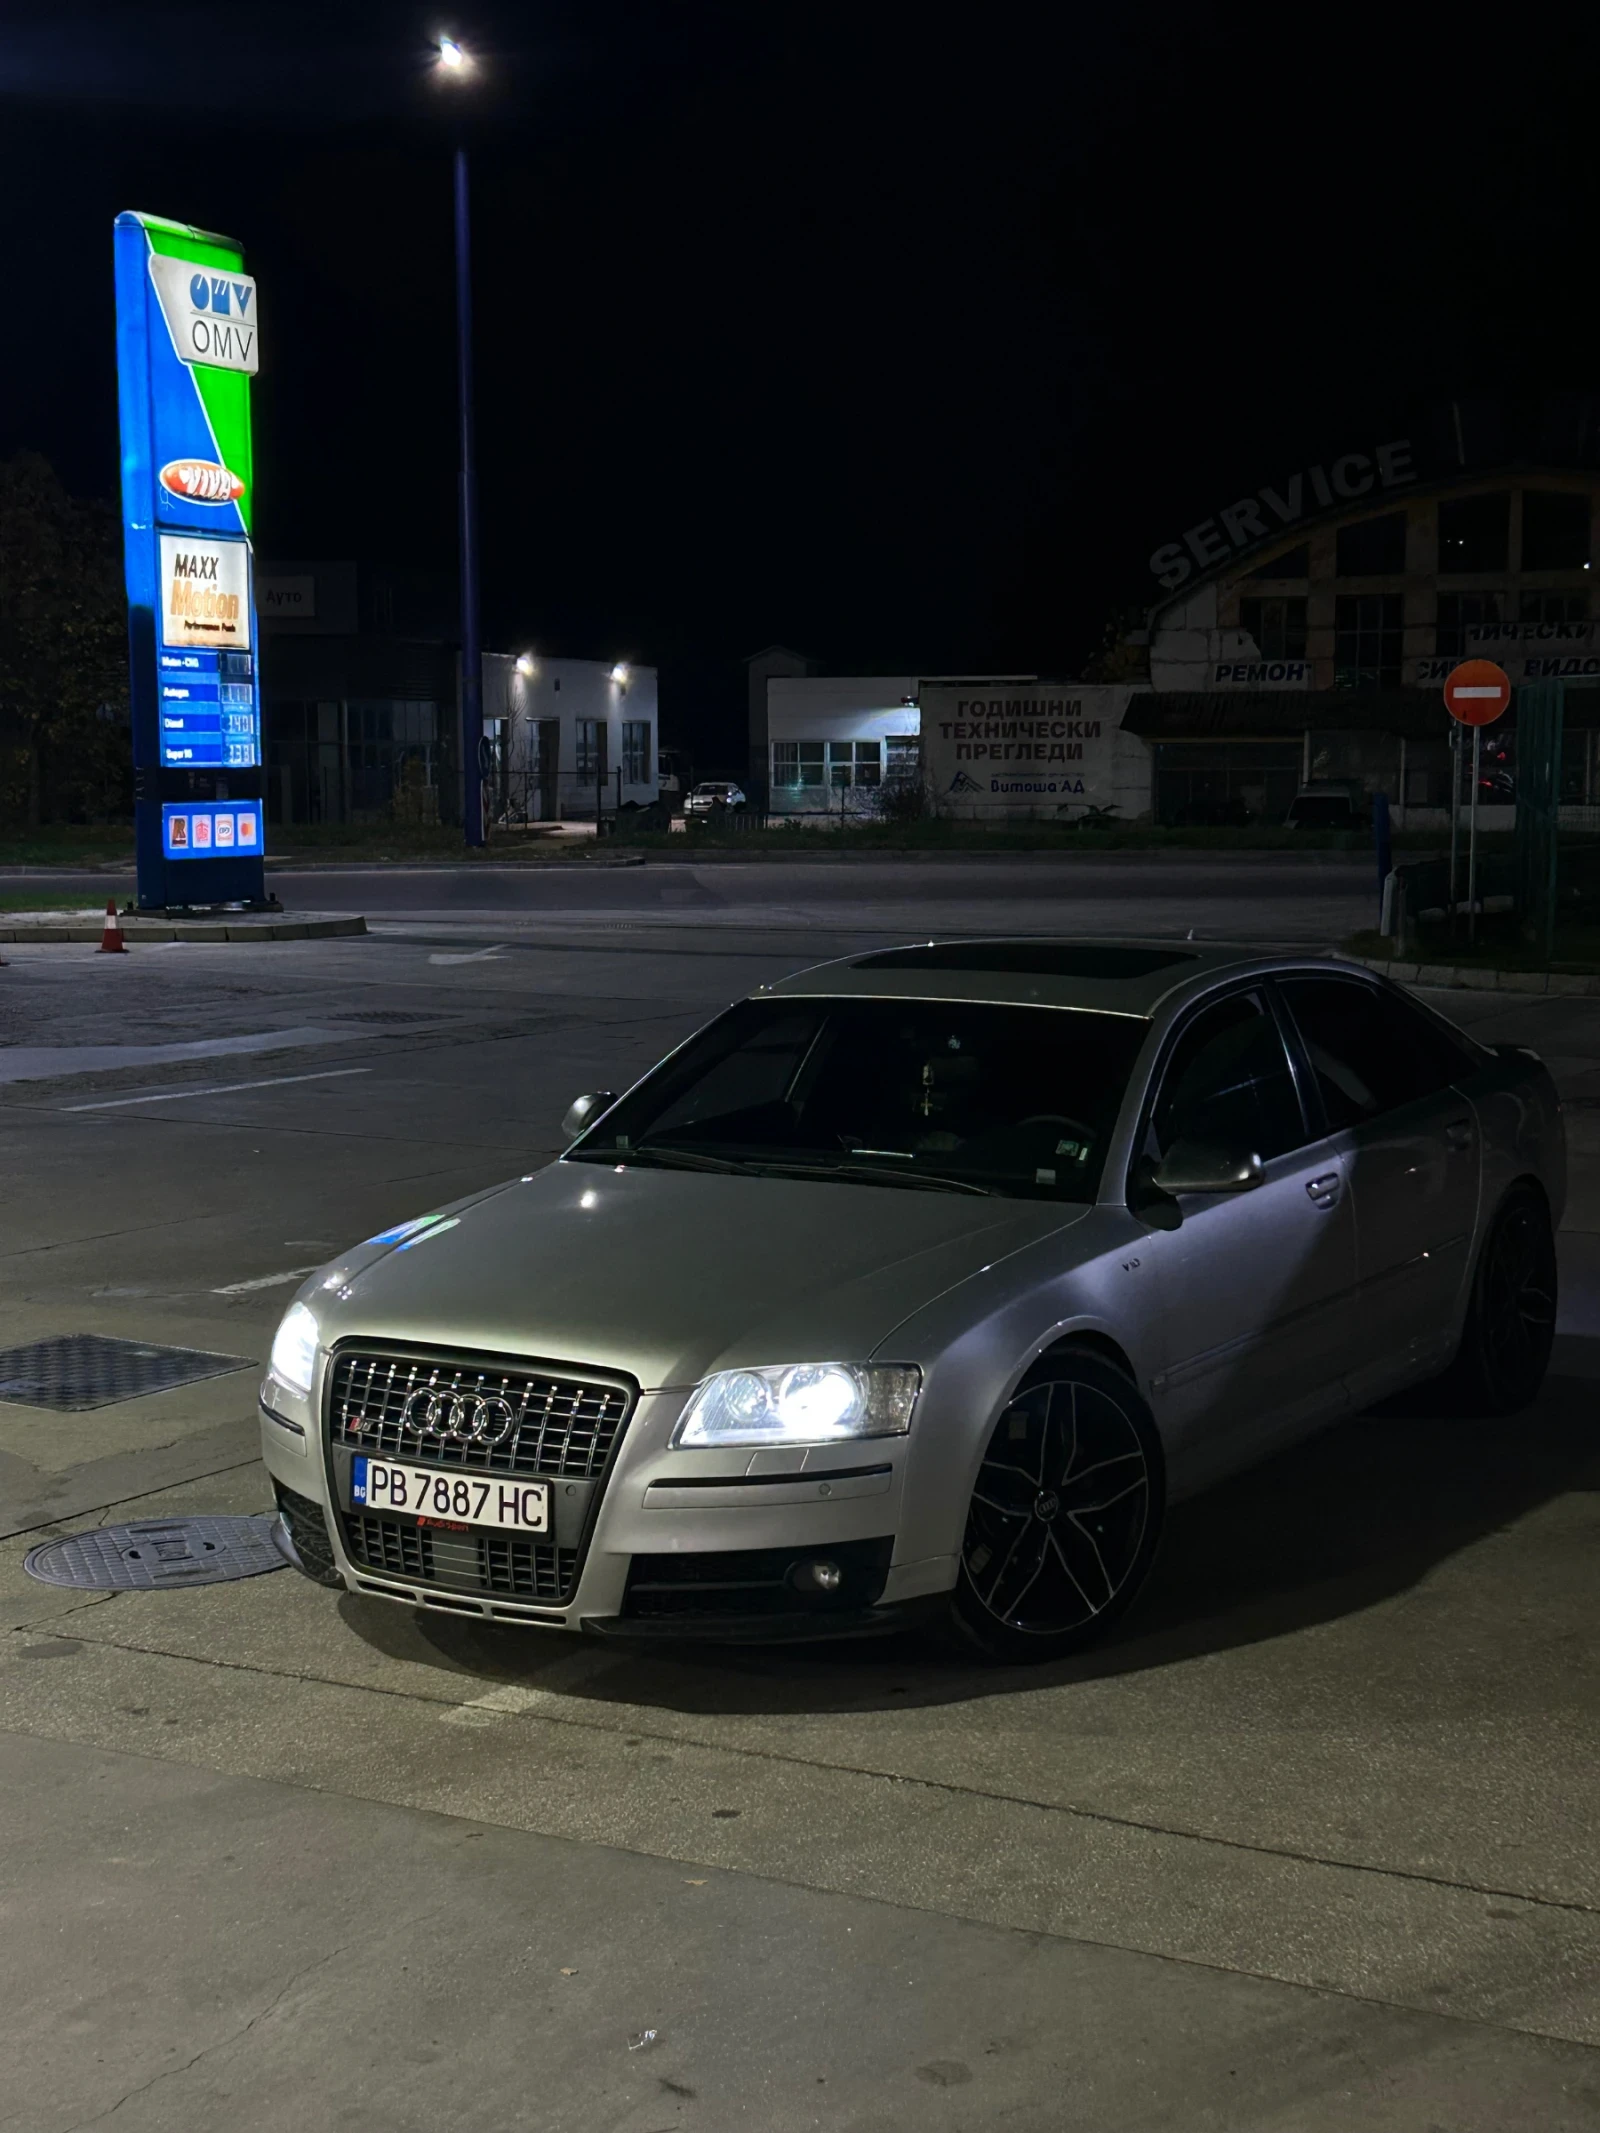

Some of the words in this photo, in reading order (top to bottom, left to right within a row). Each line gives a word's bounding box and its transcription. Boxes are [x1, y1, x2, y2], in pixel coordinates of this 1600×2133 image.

[192, 320, 253, 361] OMV
[1149, 439, 1419, 590] SERVICE
[174, 553, 219, 580] MAXX
[170, 579, 239, 620] Motion
[1215, 663, 1312, 682] РЕМОН
[957, 700, 1082, 720] ГОДИШНИ
[939, 721, 1101, 739] ТЕХНИЧЕСКИ
[956, 743, 1083, 763] ПРЕГЛЕДИ
[354, 1485, 366, 1498] BG
[371, 1464, 408, 1506] PB
[414, 1473, 491, 1520] 7887
[498, 1485, 542, 1527] HC
